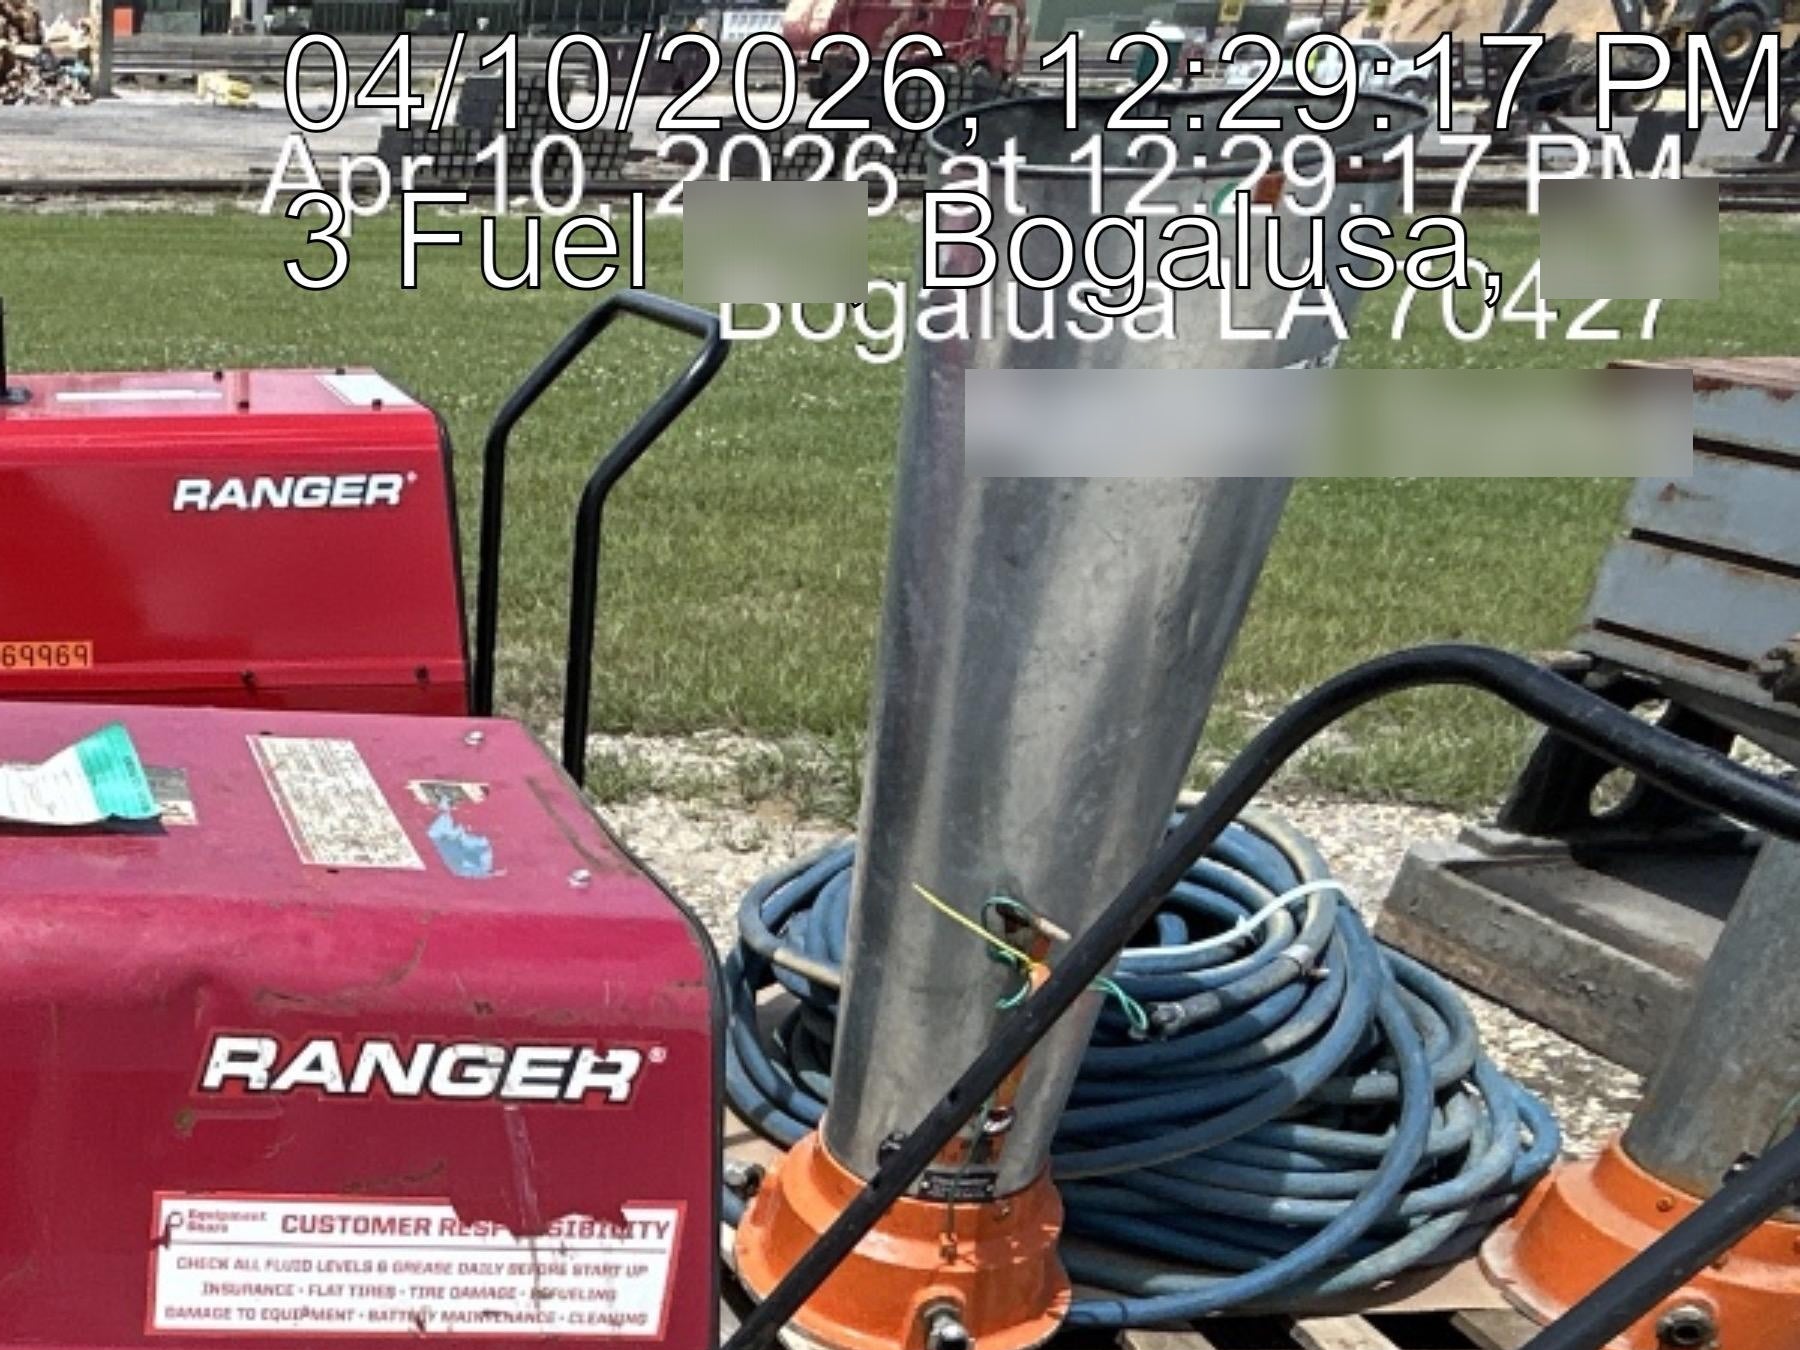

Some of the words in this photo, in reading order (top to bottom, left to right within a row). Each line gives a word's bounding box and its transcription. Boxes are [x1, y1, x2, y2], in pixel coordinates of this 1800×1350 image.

[281, 1214, 433, 1237] CUSTOMER
[176, 1256, 229, 1270] CHECK
[233, 1257, 260, 1272] ALL
[265, 1258, 313, 1273] FLUID
[317, 1260, 373, 1274] LEVELS
[392, 1261, 453, 1275] GREASE
[457, 1262, 505, 1276] DAILY
[507, 1262, 568, 1277] BEFORE
[572, 1263, 622, 1278] START
[625, 1264, 649, 1279] UP
[201, 1281, 294, 1297] INSURANCE
[308, 1283, 343, 1297] FLAT
[350, 1284, 397, 1299] TIRES
[410, 1286, 445, 1299] TIRE
[449, 1286, 517, 1300] DAMAGE
[164, 1306, 231, 1321] DAMAGE
[237, 1307, 257, 1321] TO
[260, 1306, 354, 1323] EQUIPMENT
[440, 1310, 556, 1325] MAINTENANCE
[568, 1312, 649, 1326] CLEANING
